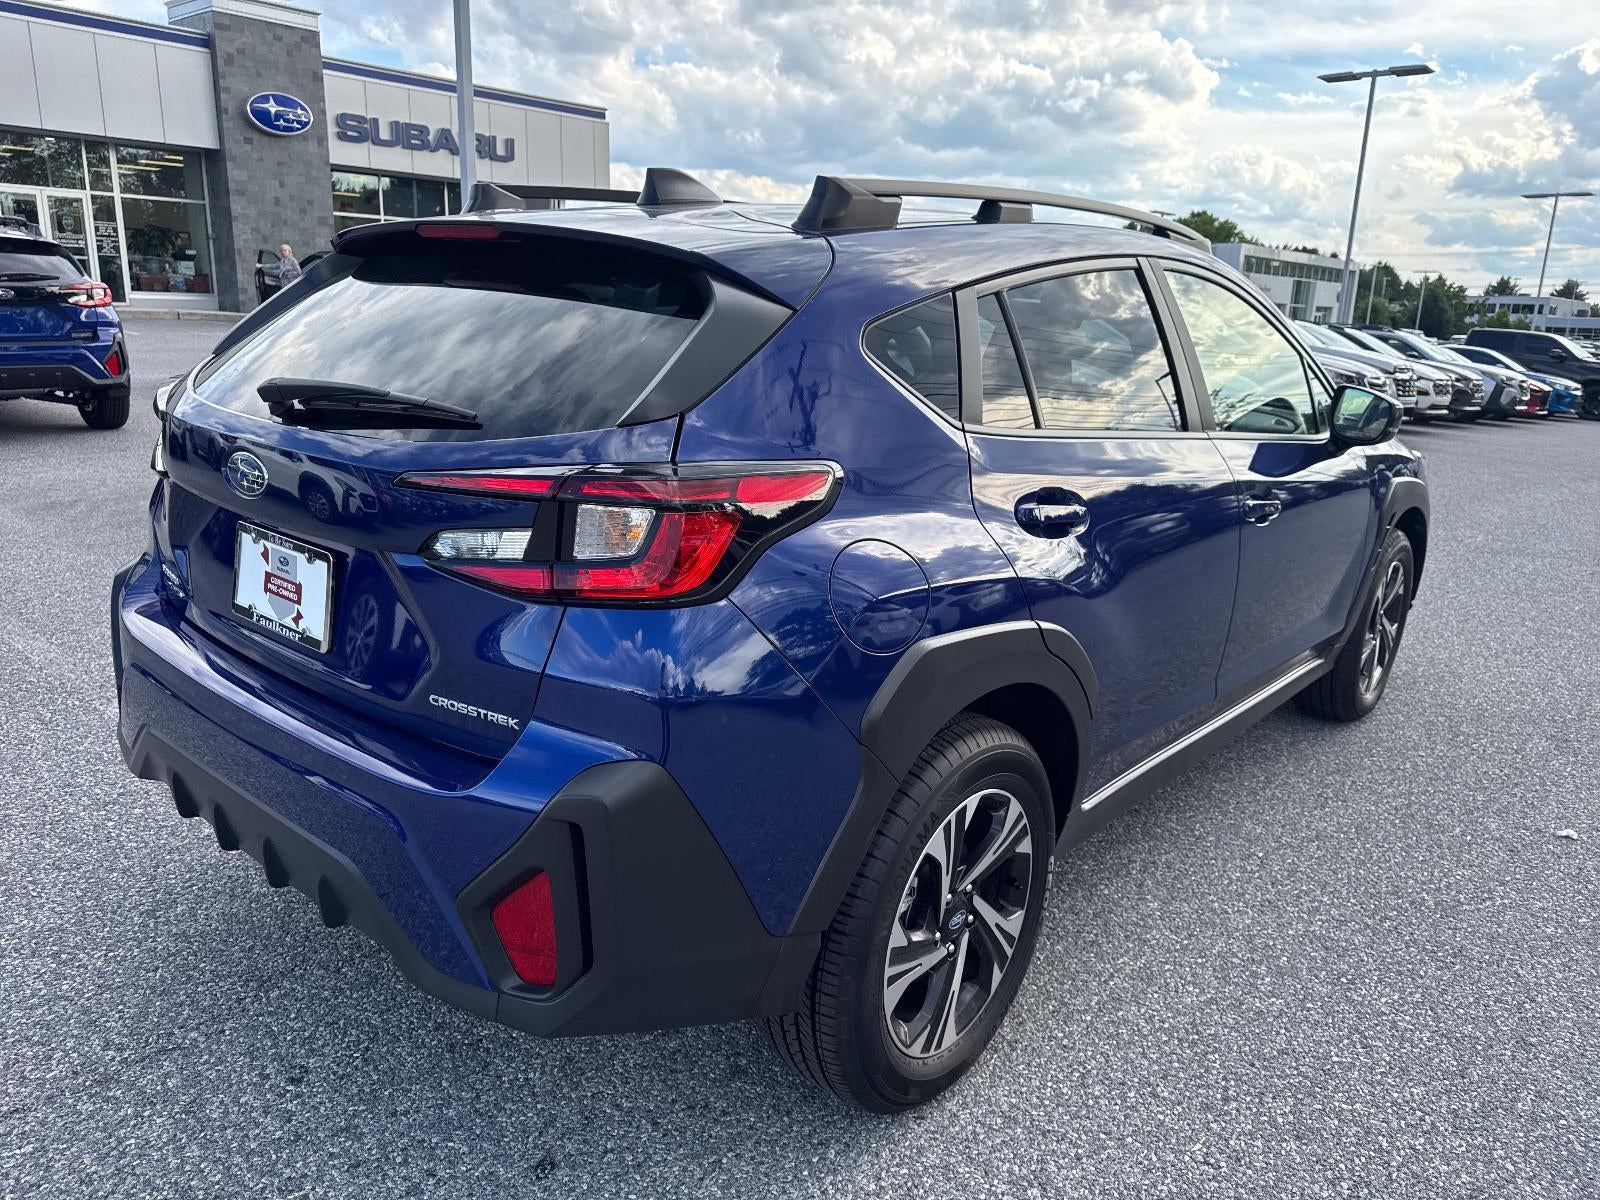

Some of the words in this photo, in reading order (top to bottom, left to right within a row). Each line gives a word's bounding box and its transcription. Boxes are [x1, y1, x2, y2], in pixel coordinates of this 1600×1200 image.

[268, 533, 274, 543] To
[267, 583, 298, 601] PRE-OWNED
[270, 576, 296, 592] CERTIFIED
[252, 611, 302, 642] Faulkner
[429, 694, 520, 730] CROSSTREK
